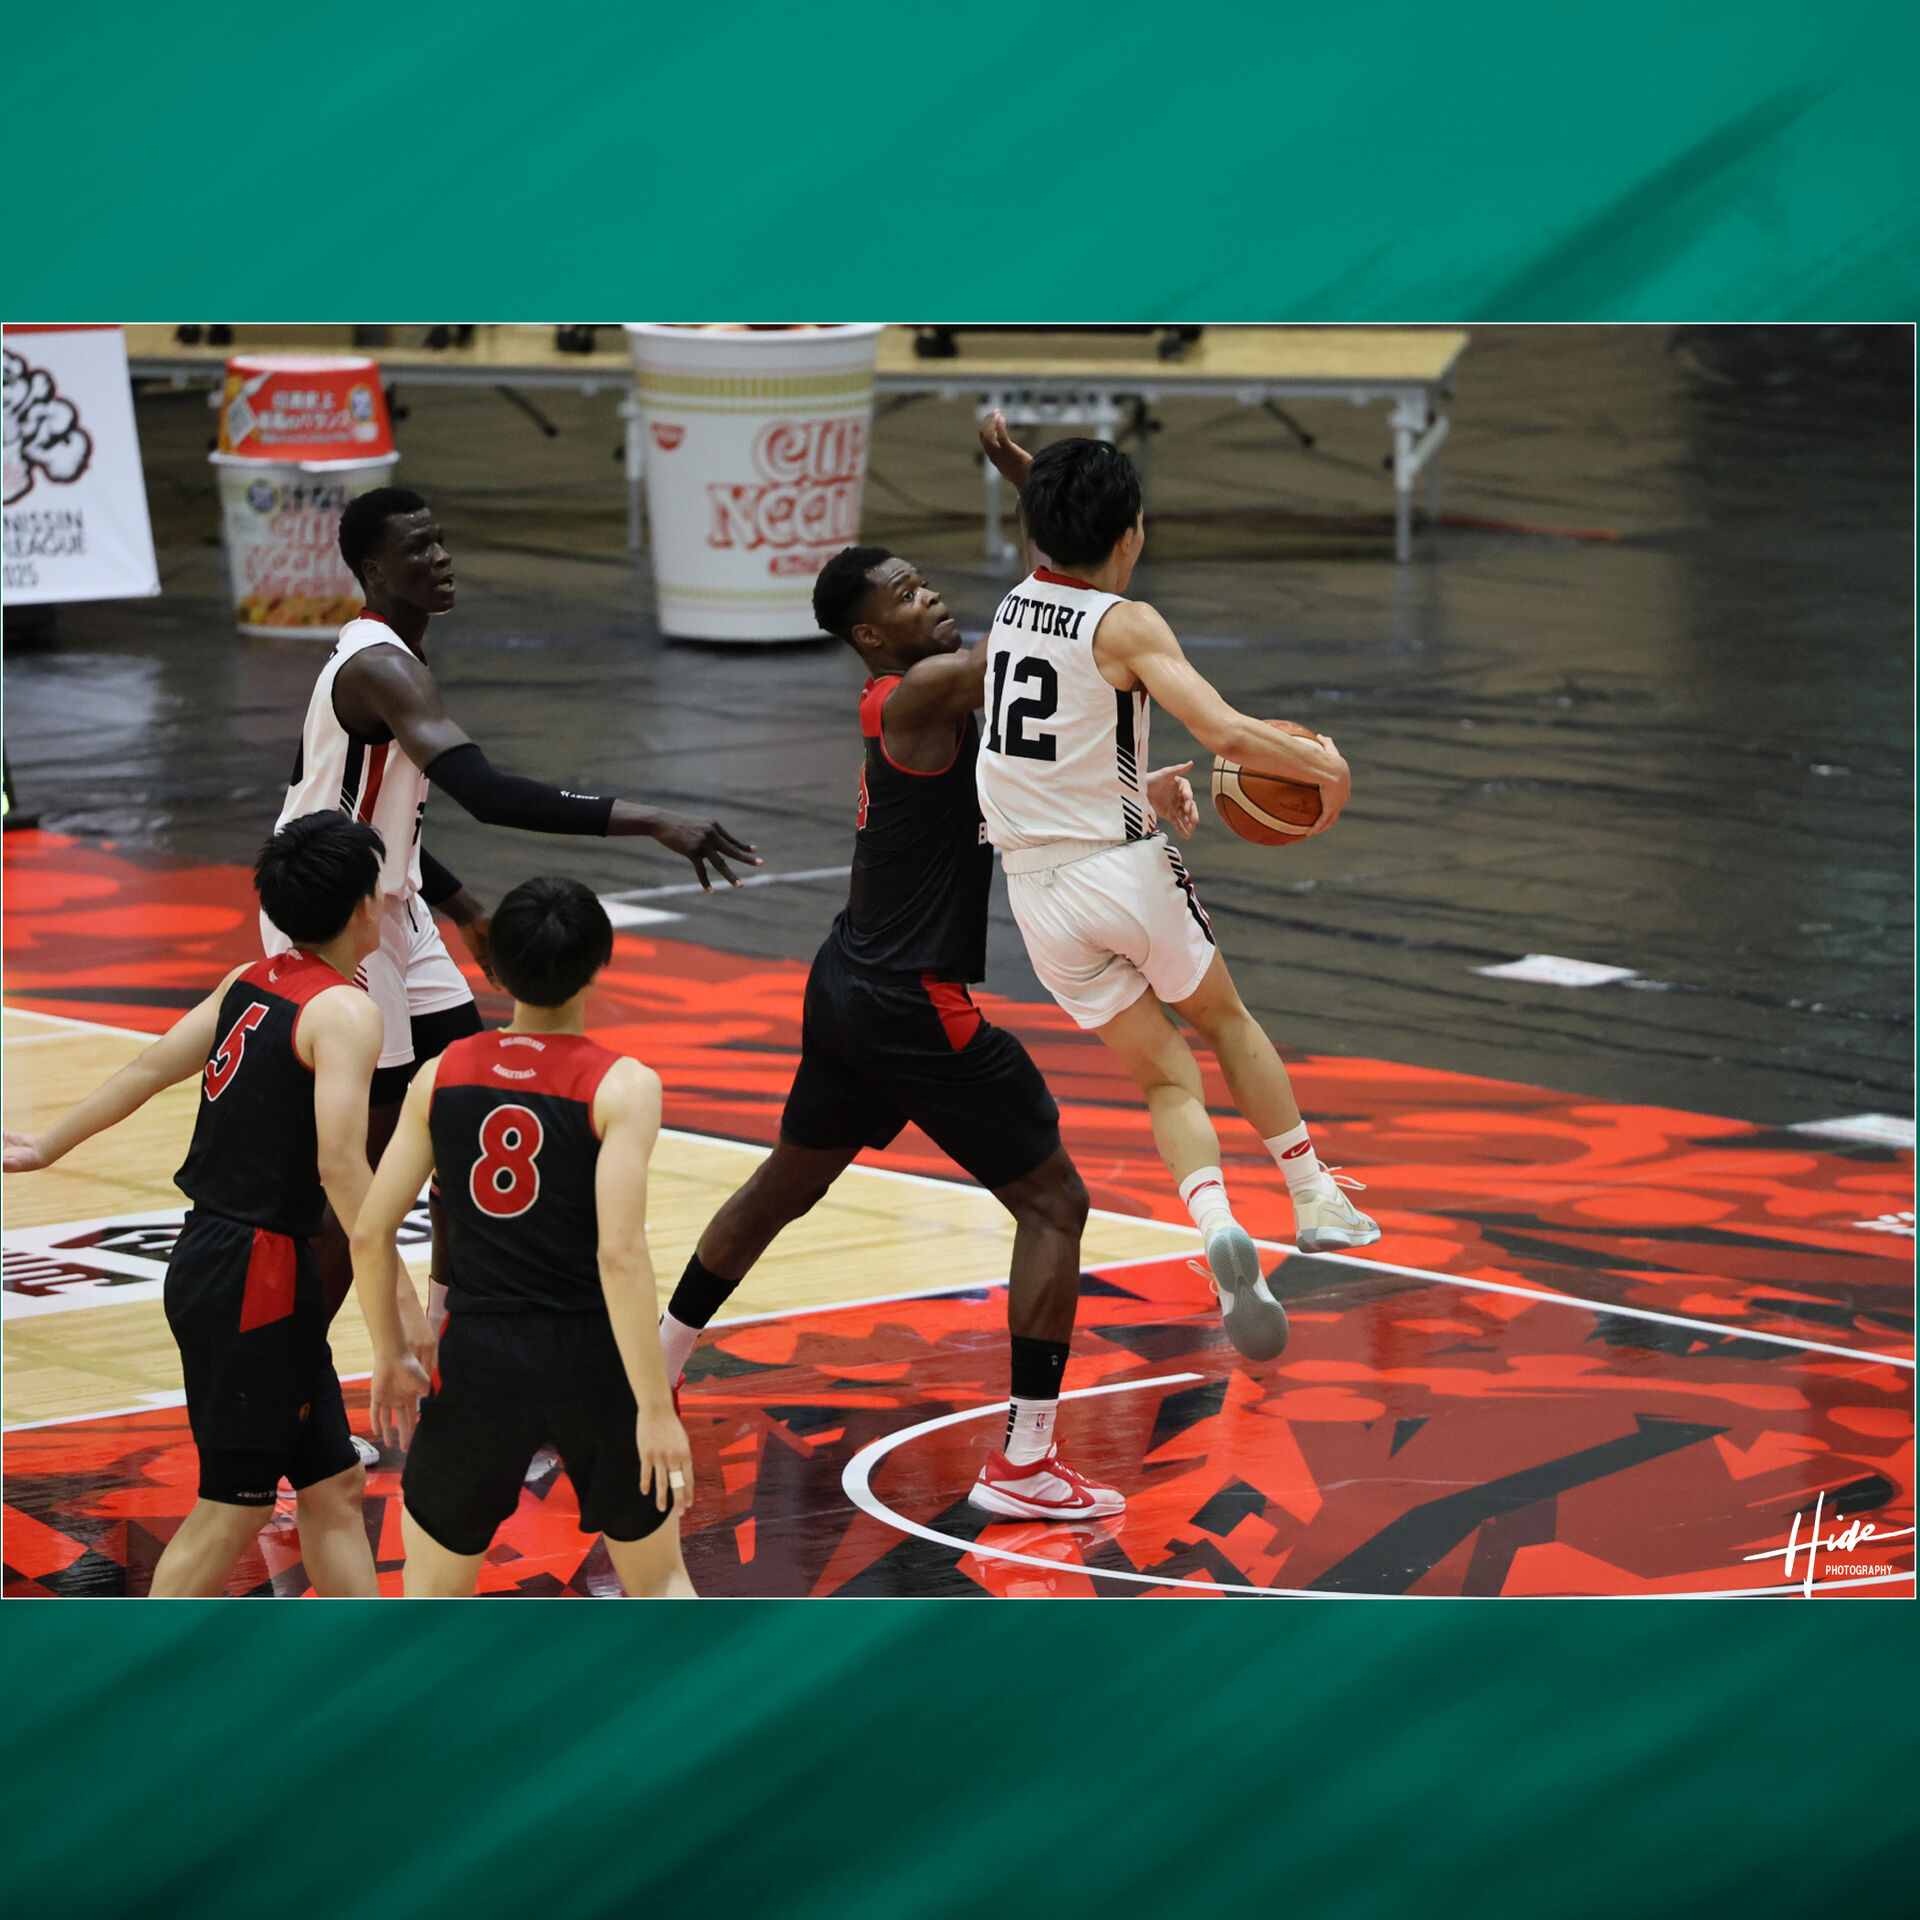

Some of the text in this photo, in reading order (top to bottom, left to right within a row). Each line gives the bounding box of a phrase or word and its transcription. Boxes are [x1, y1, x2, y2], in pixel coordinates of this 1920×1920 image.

[986, 650, 1057, 762] 12
[204, 1001, 270, 1102] 5
[469, 1104, 544, 1218] 8
